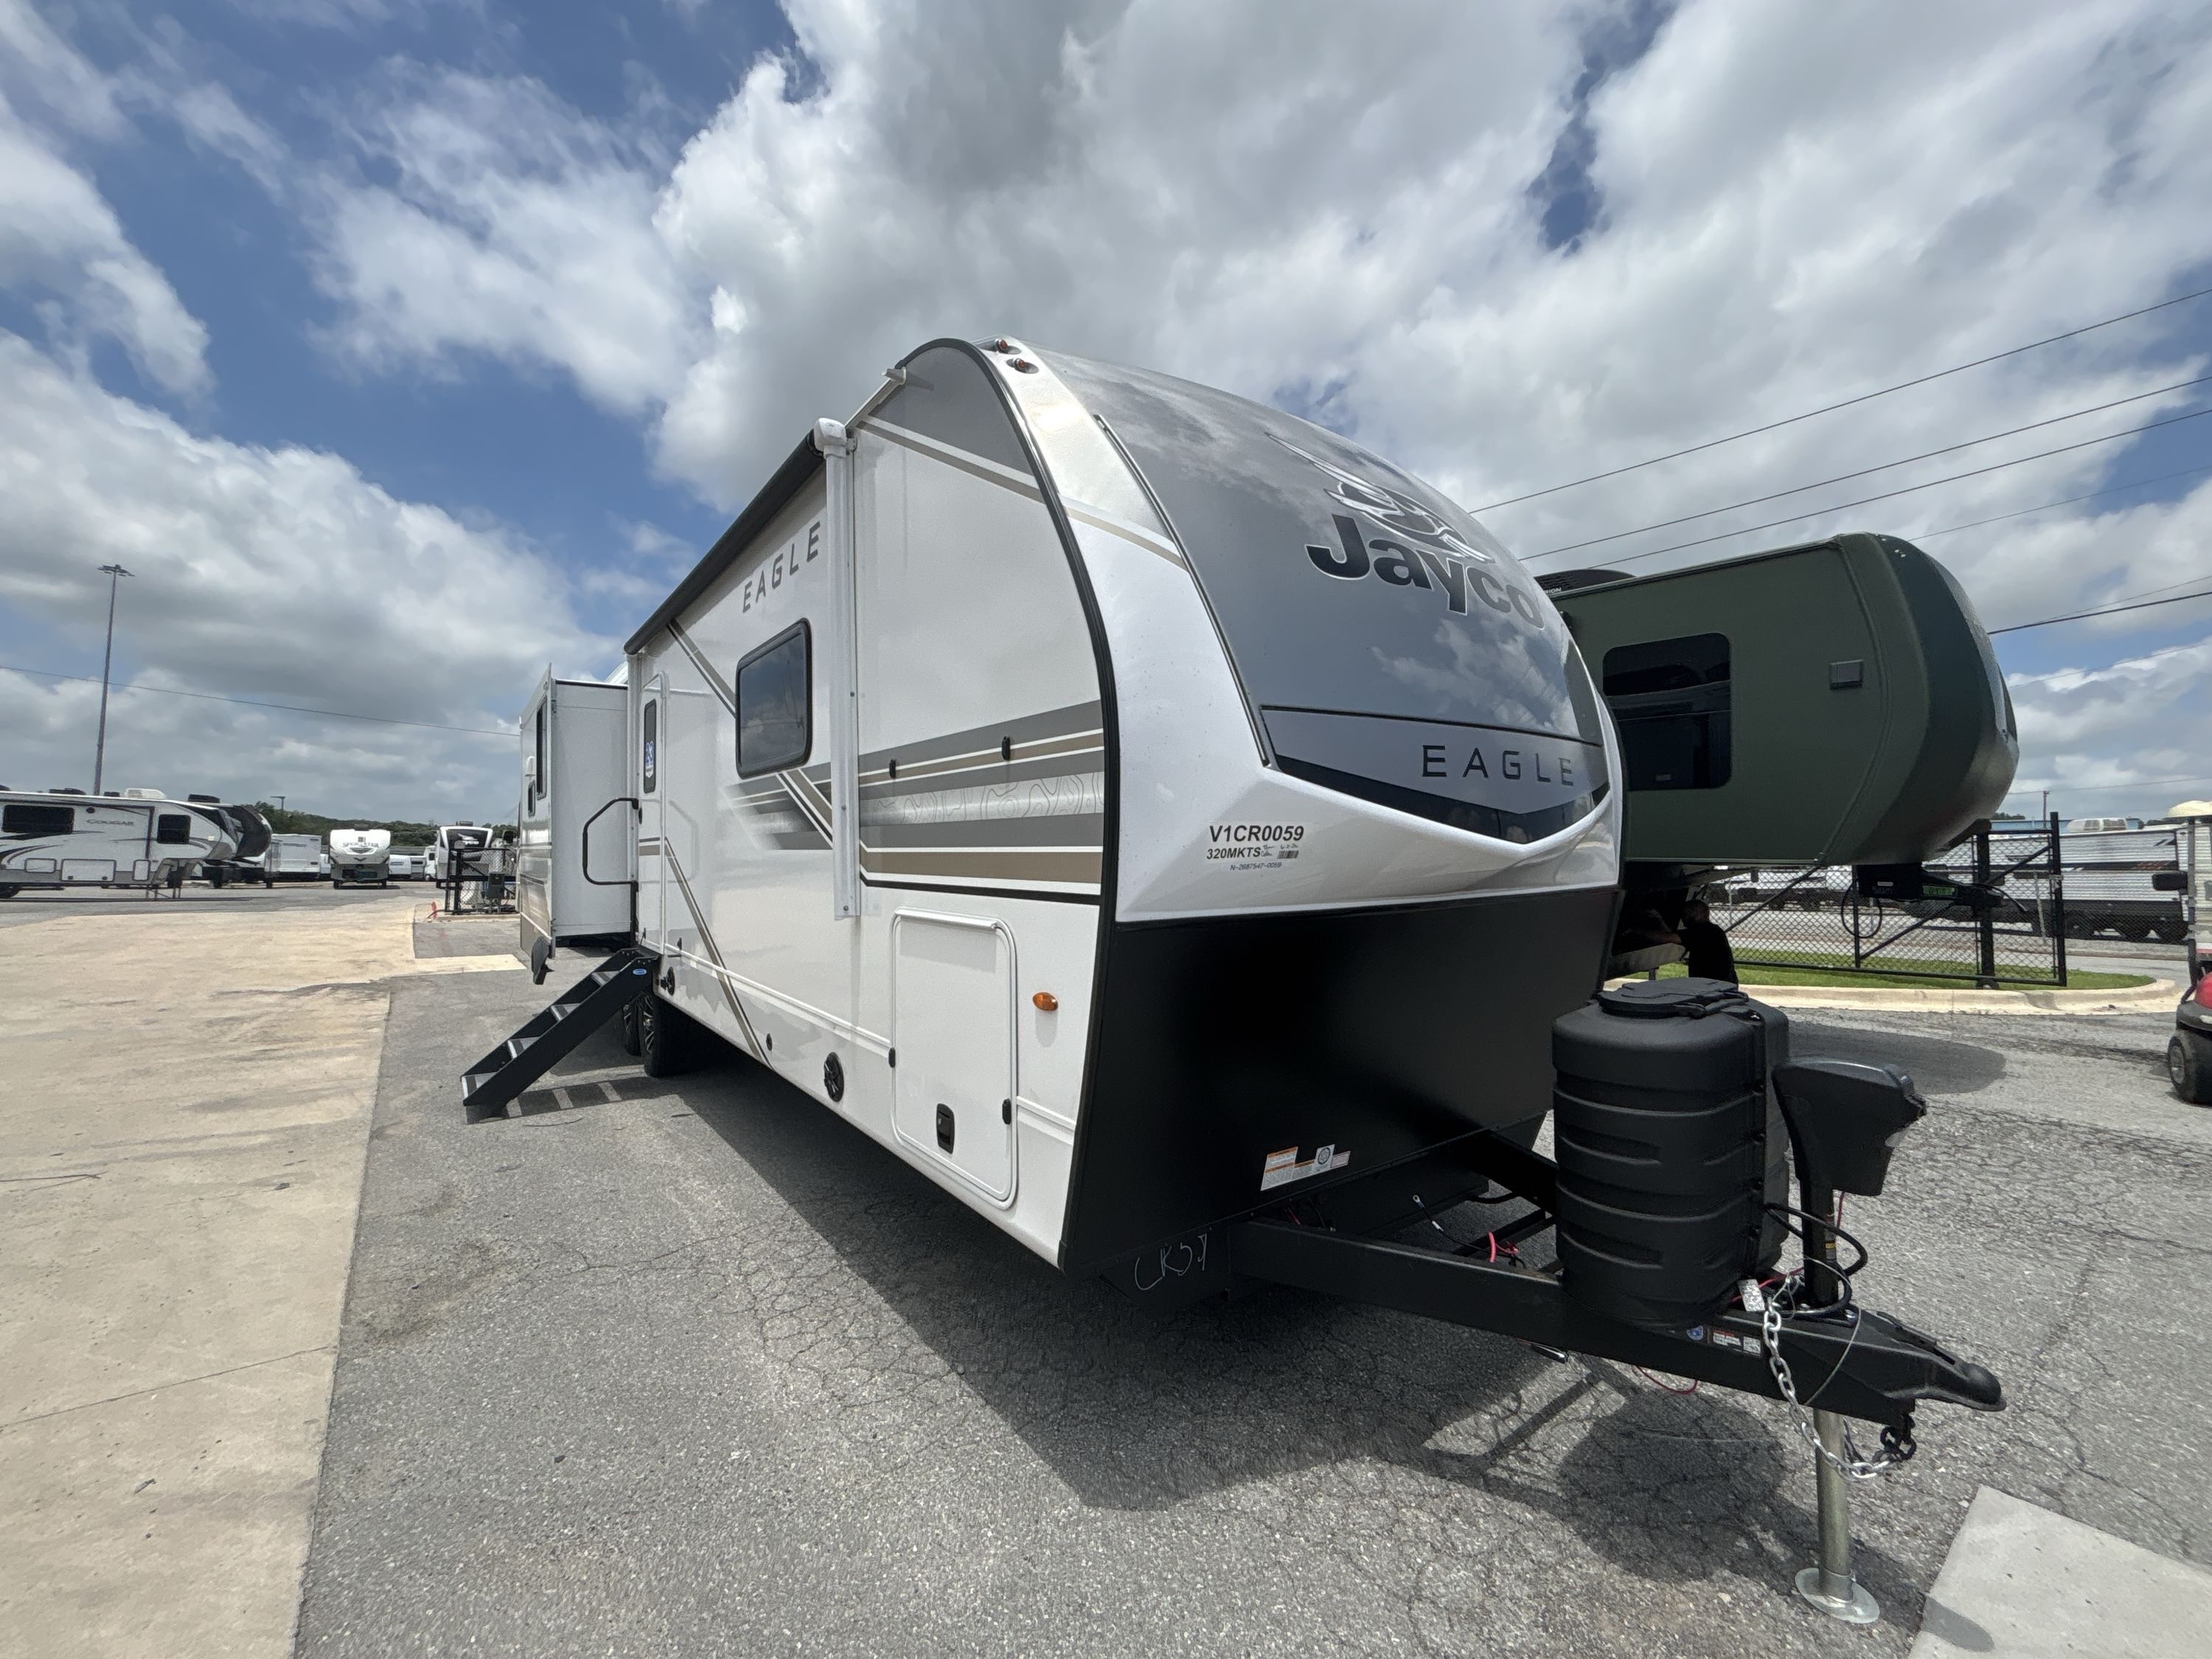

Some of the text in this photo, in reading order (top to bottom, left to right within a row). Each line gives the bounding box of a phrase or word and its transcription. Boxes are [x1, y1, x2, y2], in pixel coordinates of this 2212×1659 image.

[742, 521, 821, 613] EAGLE
[1304, 513, 1545, 630] Jayco
[1422, 744, 1573, 787] EAGLE
[1206, 846, 1262, 860] 320MKTS
[1209, 825, 1304, 843] V1CR0059
